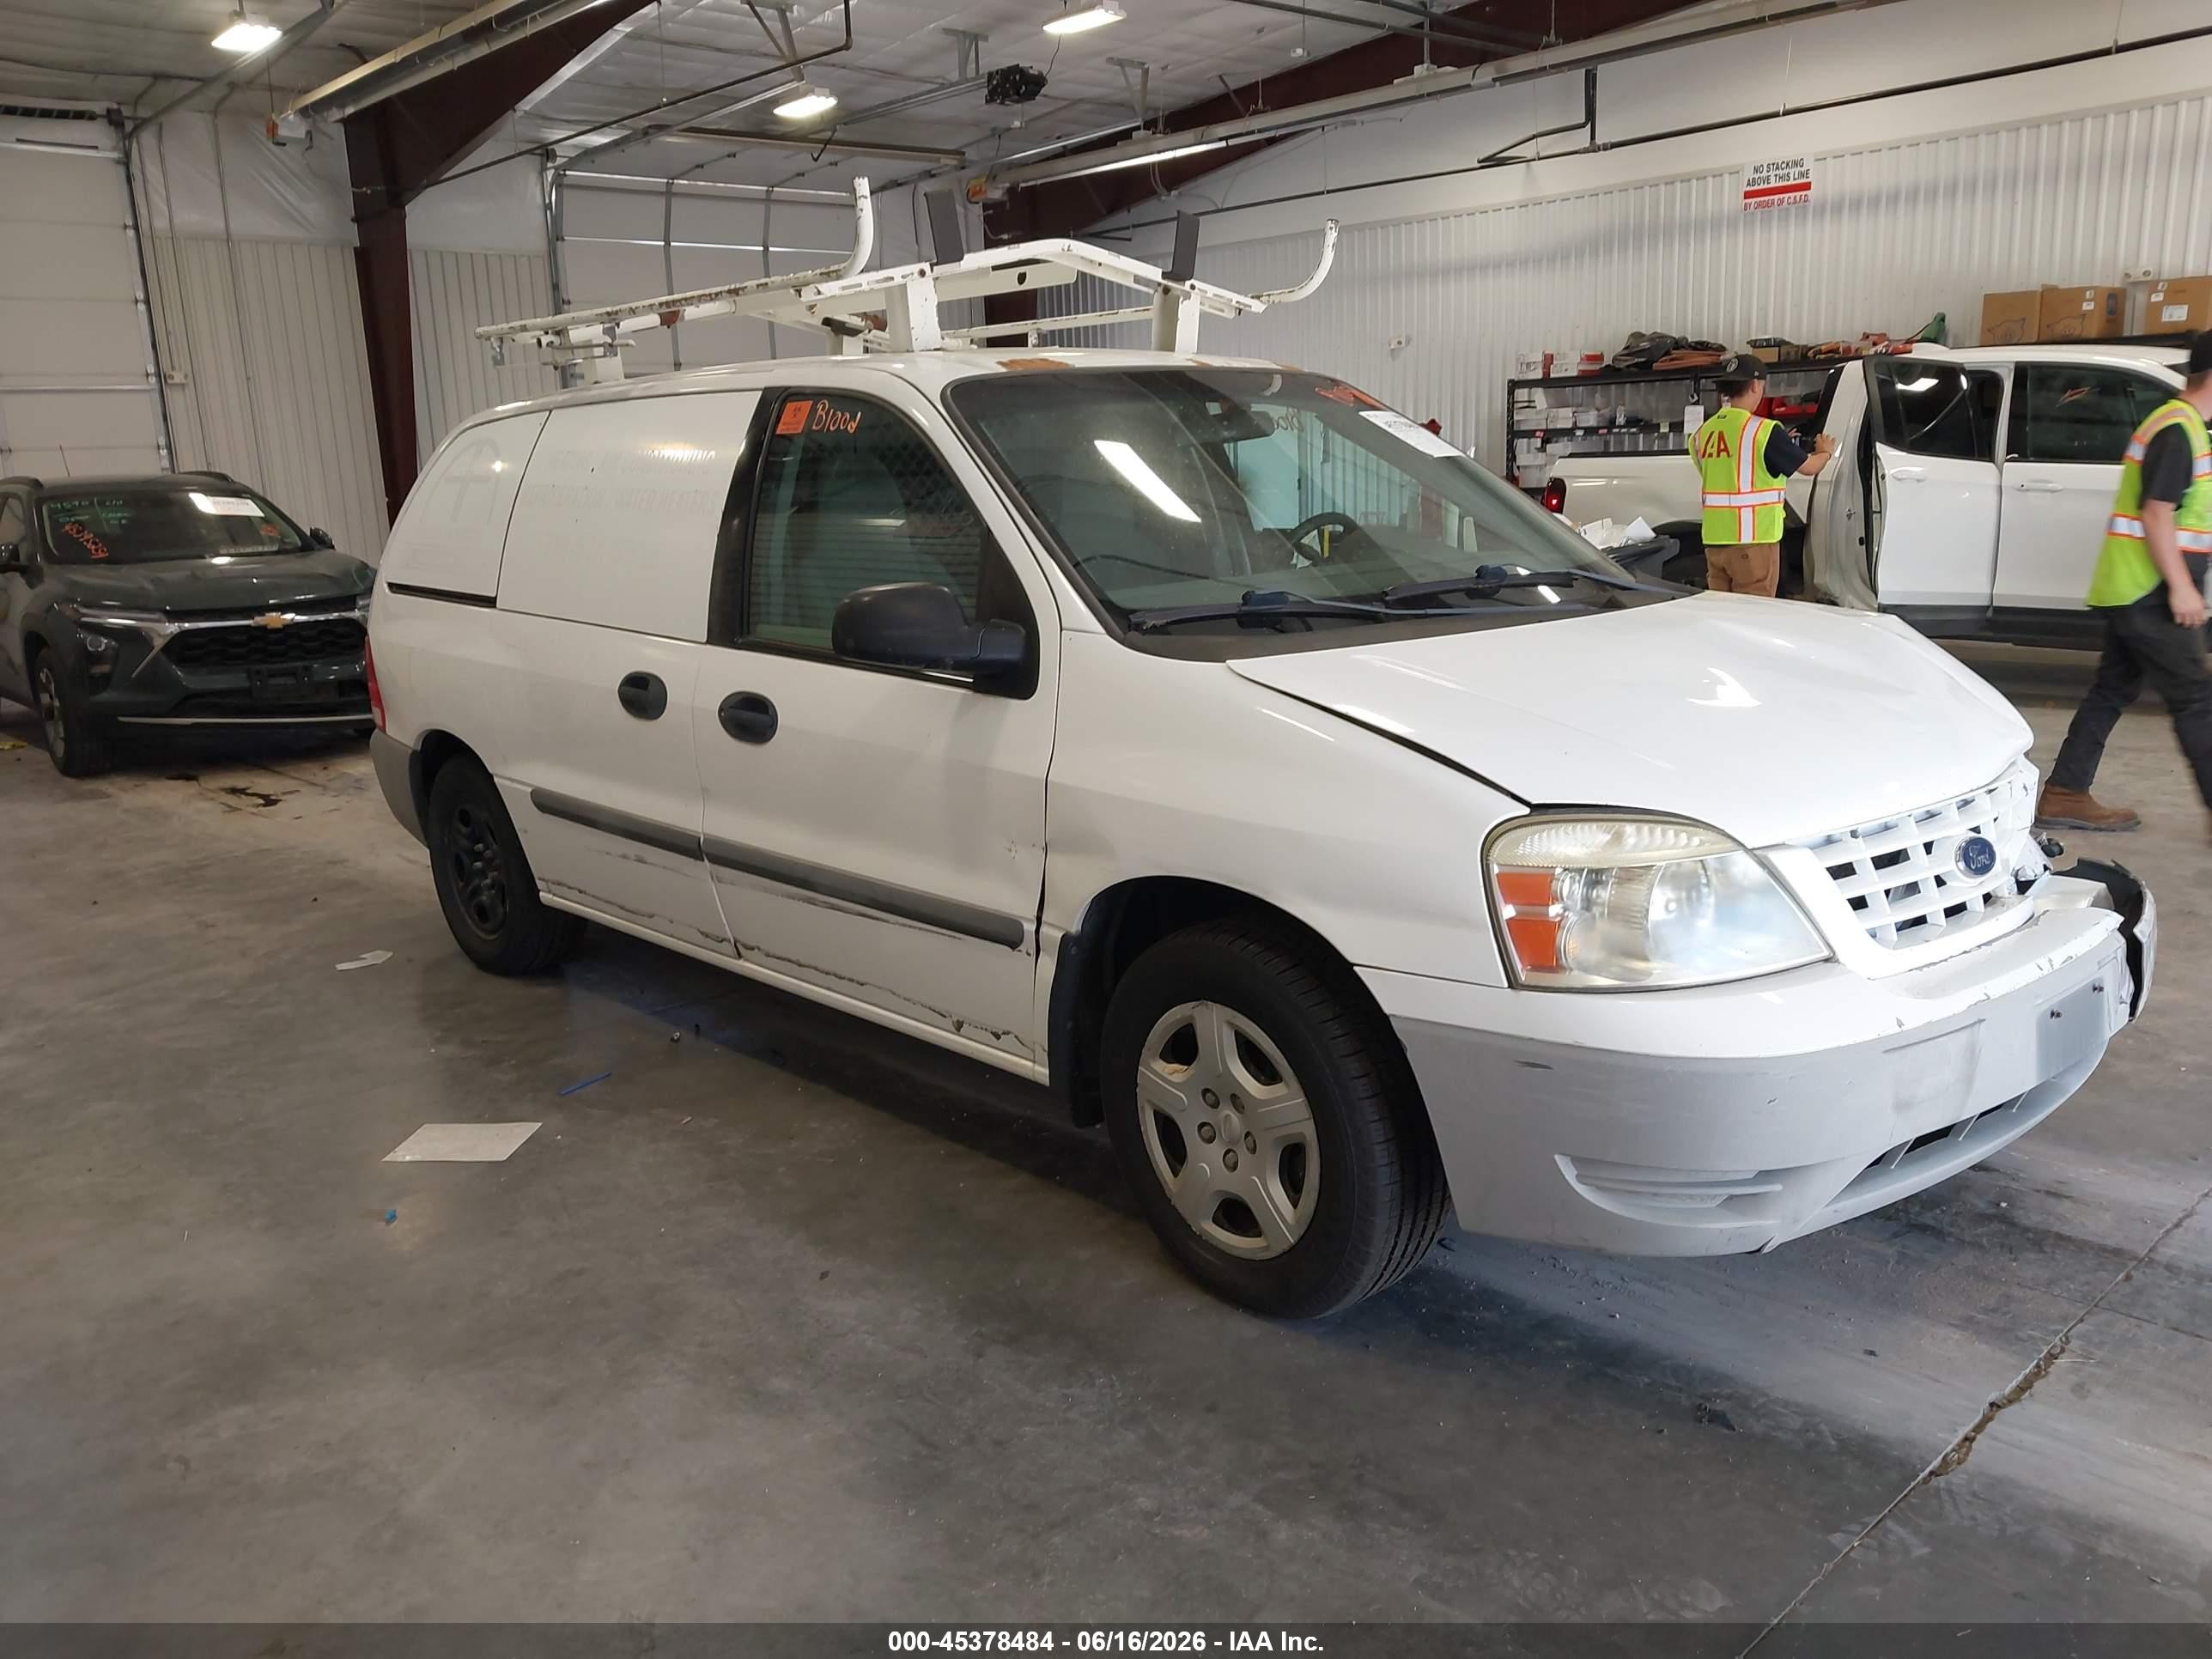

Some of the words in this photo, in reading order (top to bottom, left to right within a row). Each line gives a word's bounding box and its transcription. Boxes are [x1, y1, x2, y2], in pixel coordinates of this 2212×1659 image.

[1753, 164, 1764, 175] NO
[1766, 158, 1804, 173] STACKING
[1746, 175, 1771, 187] ABOVE
[1774, 172, 1790, 183] THIS
[1793, 169, 1810, 180] LINE
[1743, 201, 1753, 211] BY
[1753, 198, 1775, 209] ORDER
[1777, 197, 1786, 207] OF
[812, 399, 861, 433] Blood
[1968, 845, 1991, 870] Ford
